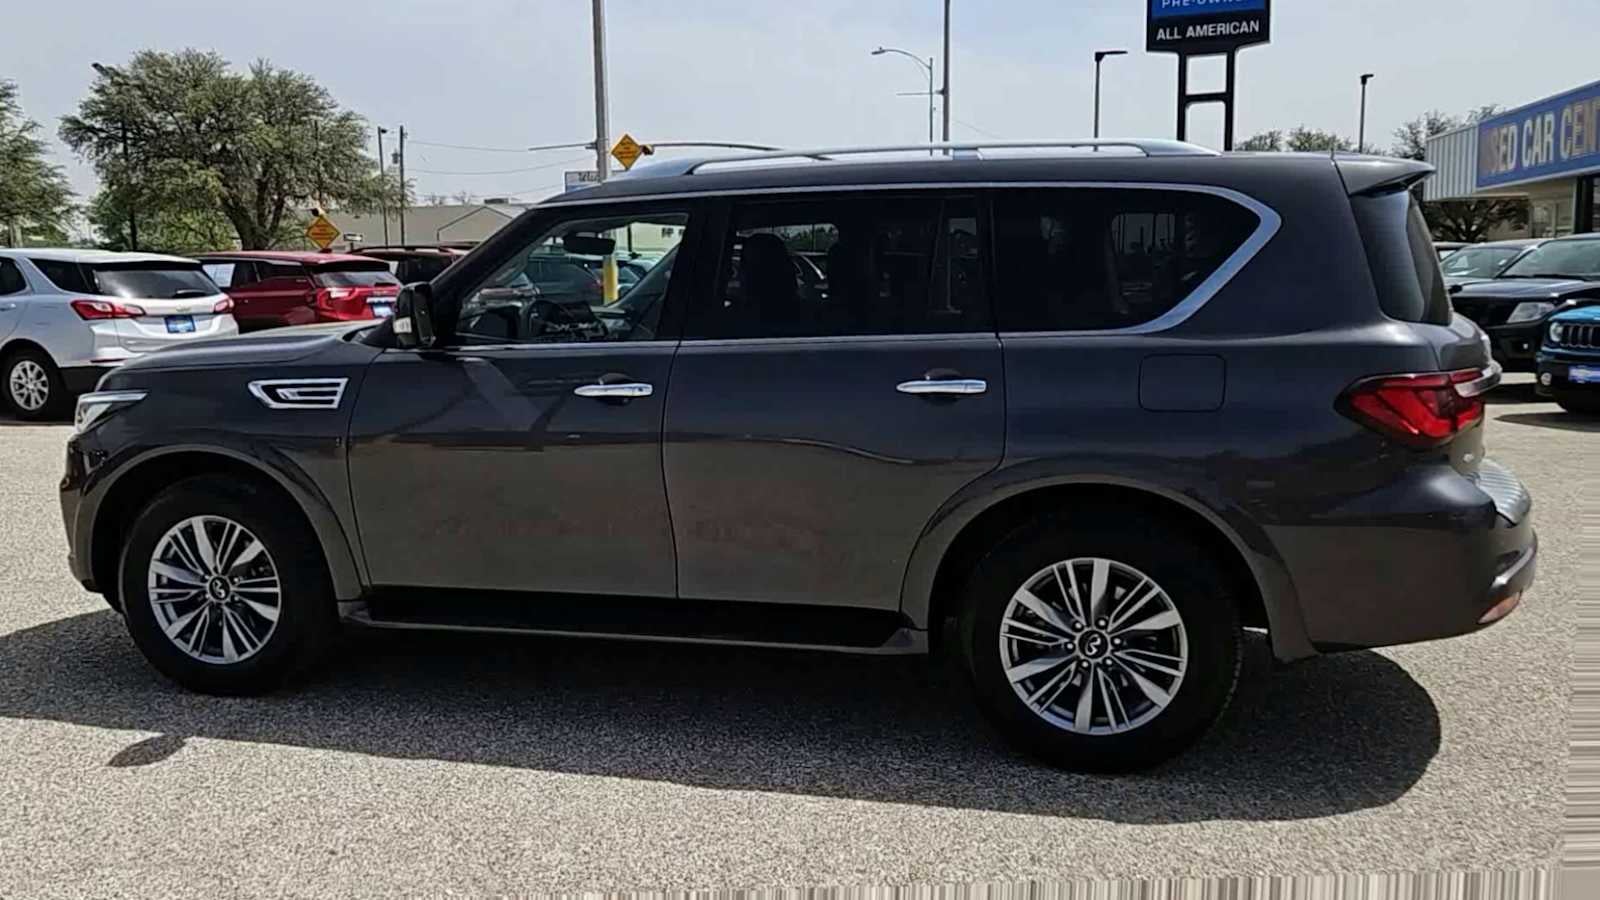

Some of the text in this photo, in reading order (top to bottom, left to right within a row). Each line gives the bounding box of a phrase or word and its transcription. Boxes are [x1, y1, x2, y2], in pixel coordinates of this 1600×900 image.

[1161, 0, 1245, 9] PRE-O
[1156, 20, 1259, 40] ALL AMERICAN
[1481, 125, 1517, 174] SED
[1522, 113, 1555, 168] CAR
